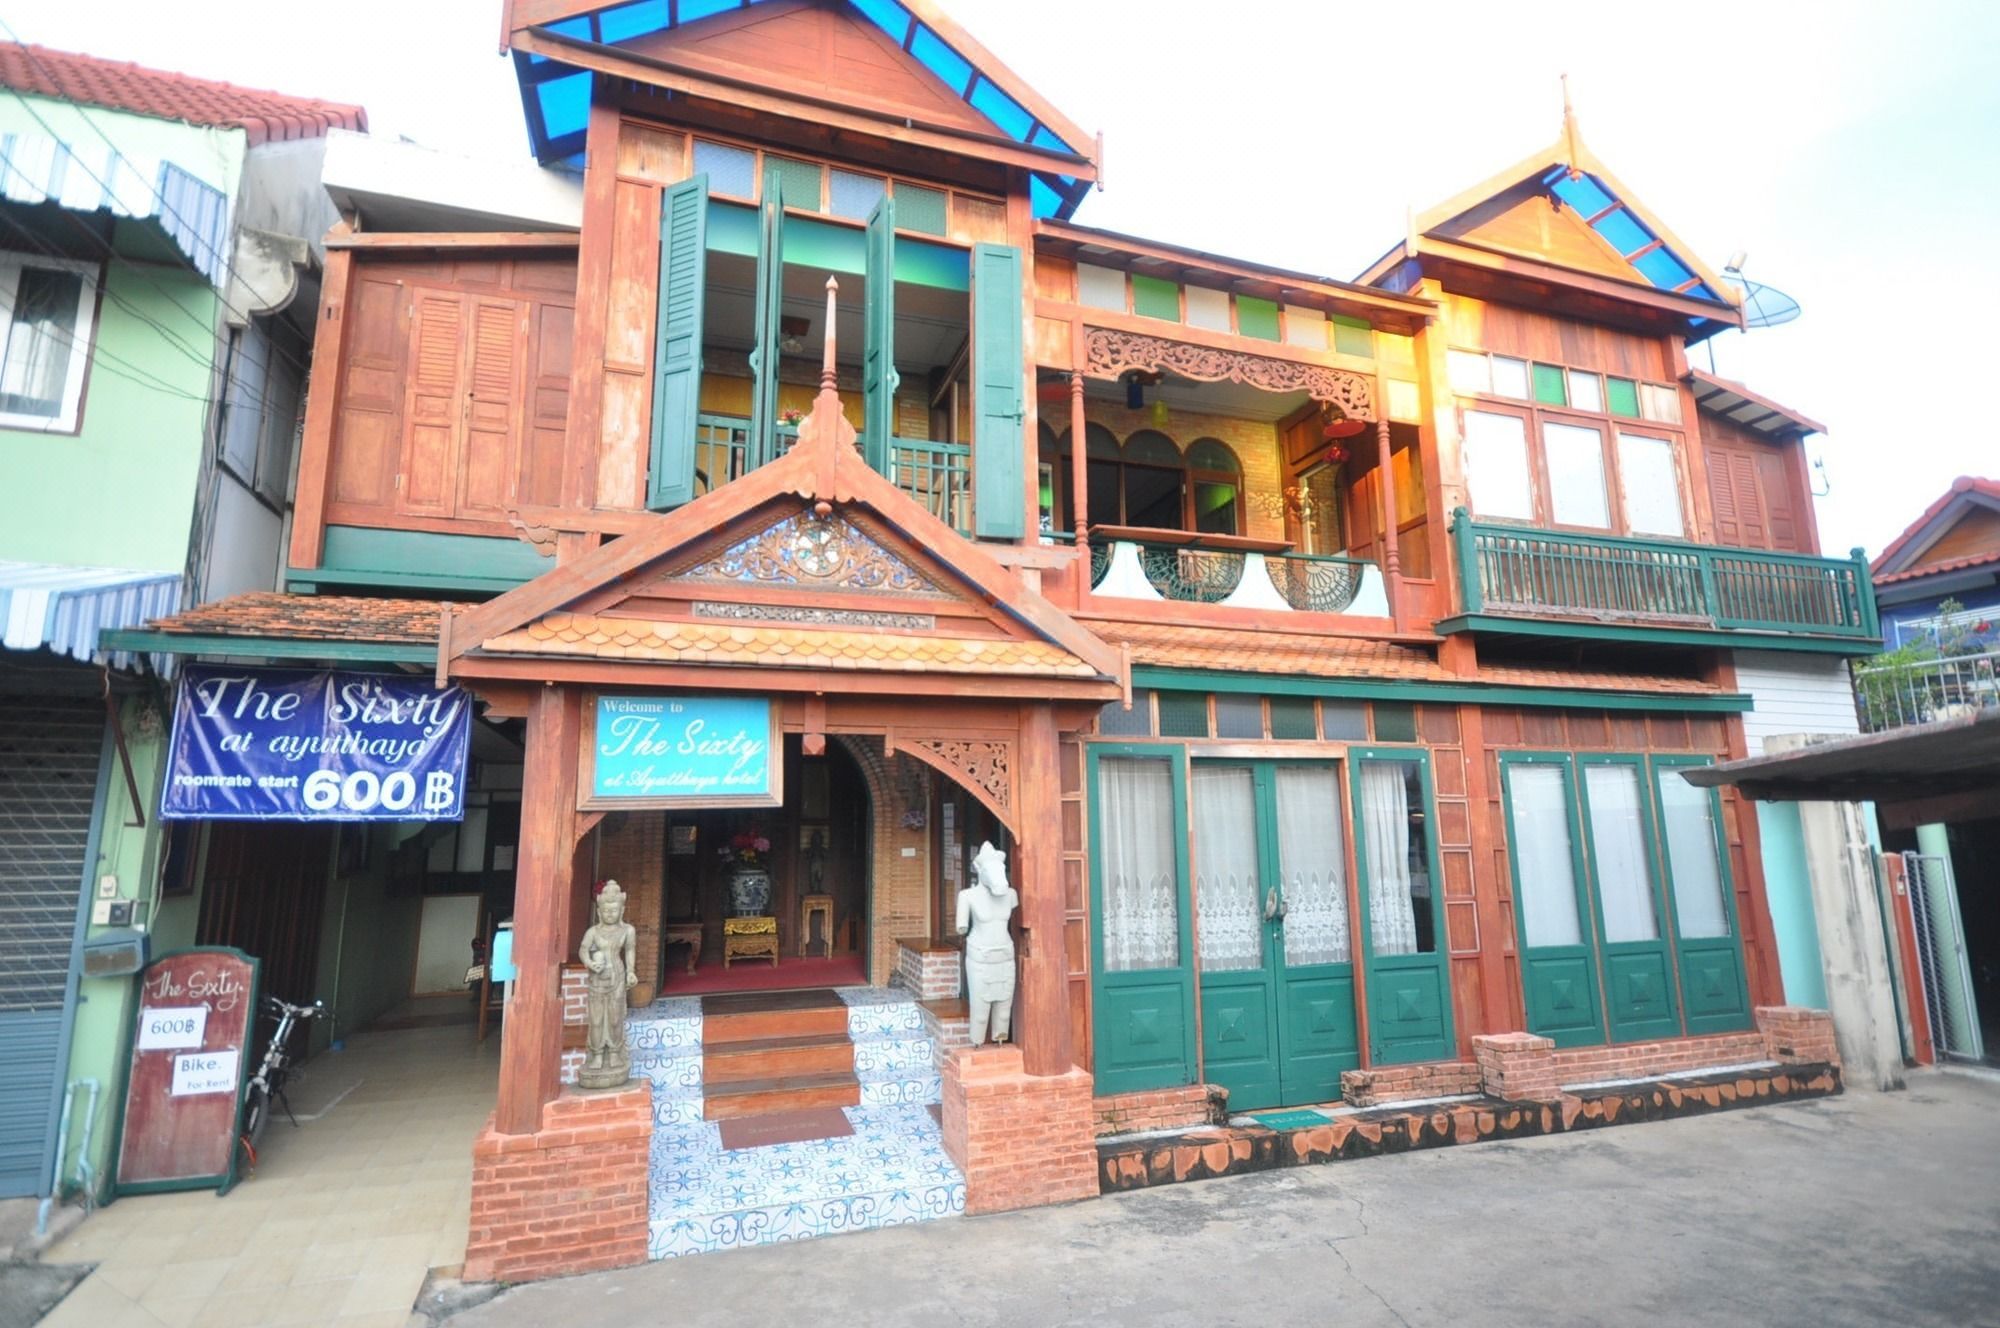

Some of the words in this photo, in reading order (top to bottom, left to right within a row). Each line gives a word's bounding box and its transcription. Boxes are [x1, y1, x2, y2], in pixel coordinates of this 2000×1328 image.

[196, 675, 301, 721] The
[330, 683, 460, 736] Sixty
[604, 700, 664, 713] Welcome
[670, 701, 683, 713] to
[219, 731, 254, 752] at
[268, 729, 426, 763] ayutthaya
[601, 715, 671, 756] The
[677, 719, 765, 770] Sixty
[174, 774, 252, 788] roomrate
[257, 774, 299, 788] start
[302, 769, 416, 811] 600
[603, 772, 624, 787] at
[722, 767, 763, 785] hotel
[145, 971, 186, 999] The
